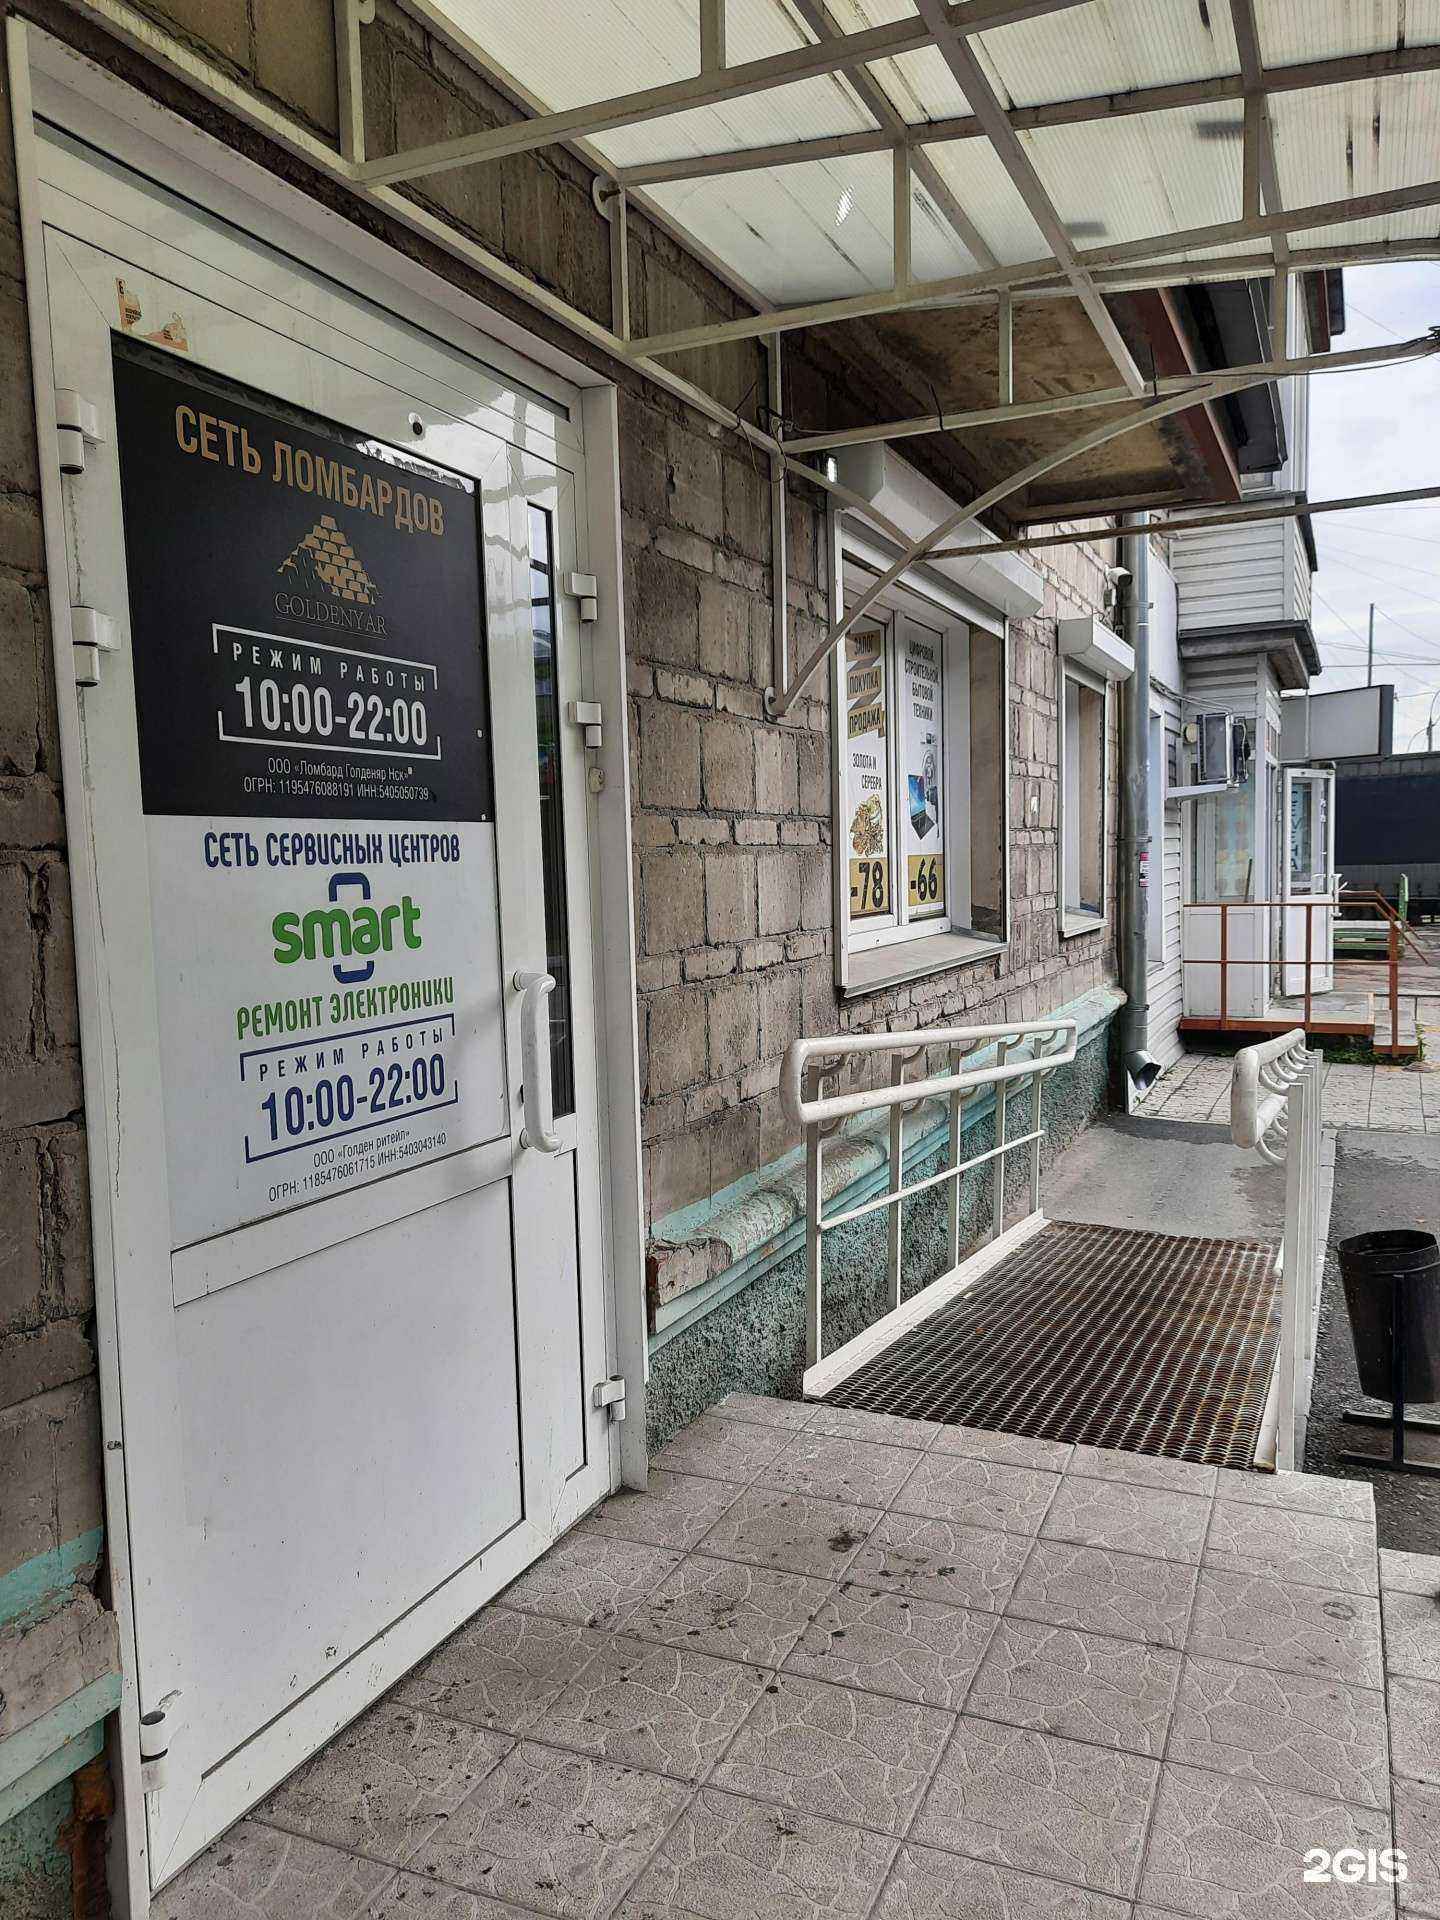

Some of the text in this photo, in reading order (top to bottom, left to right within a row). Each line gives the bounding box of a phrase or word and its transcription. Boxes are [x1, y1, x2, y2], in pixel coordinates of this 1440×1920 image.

[175, 405, 444, 536] СЕТЬ ЛОМБАРДОВ
[275, 592, 389, 635] GOLDENYAR
[232, 642, 425, 692] РЕЖИМ РАБОТЫ
[849, 670, 879, 694] ПОКУПКА
[235, 675, 428, 746] 10:00-22:00
[849, 707, 881, 735] ПРОДАЖА
[243, 776, 276, 793] ОГРН:
[279, 779, 353, 797] 1195476088191
[268, 757, 291, 774] ООО
[204, 831, 461, 868] СЕТЬ СЕРВИСНЫХ ЦЕНТРОВ
[272, 895, 422, 964] smart
[236, 976, 454, 1041] РЕМОНТ ЭЛЕКТРОНИКИ
[259, 1027, 443, 1082] РЕЖИМ РАБОТЫ
[261, 1053, 445, 1141] 10:00-22:00
[268, 1180, 300, 1202] ОГРН:
[303, 1155, 376, 1190] 1185476061715
[313, 1148, 335, 1168] ООО
